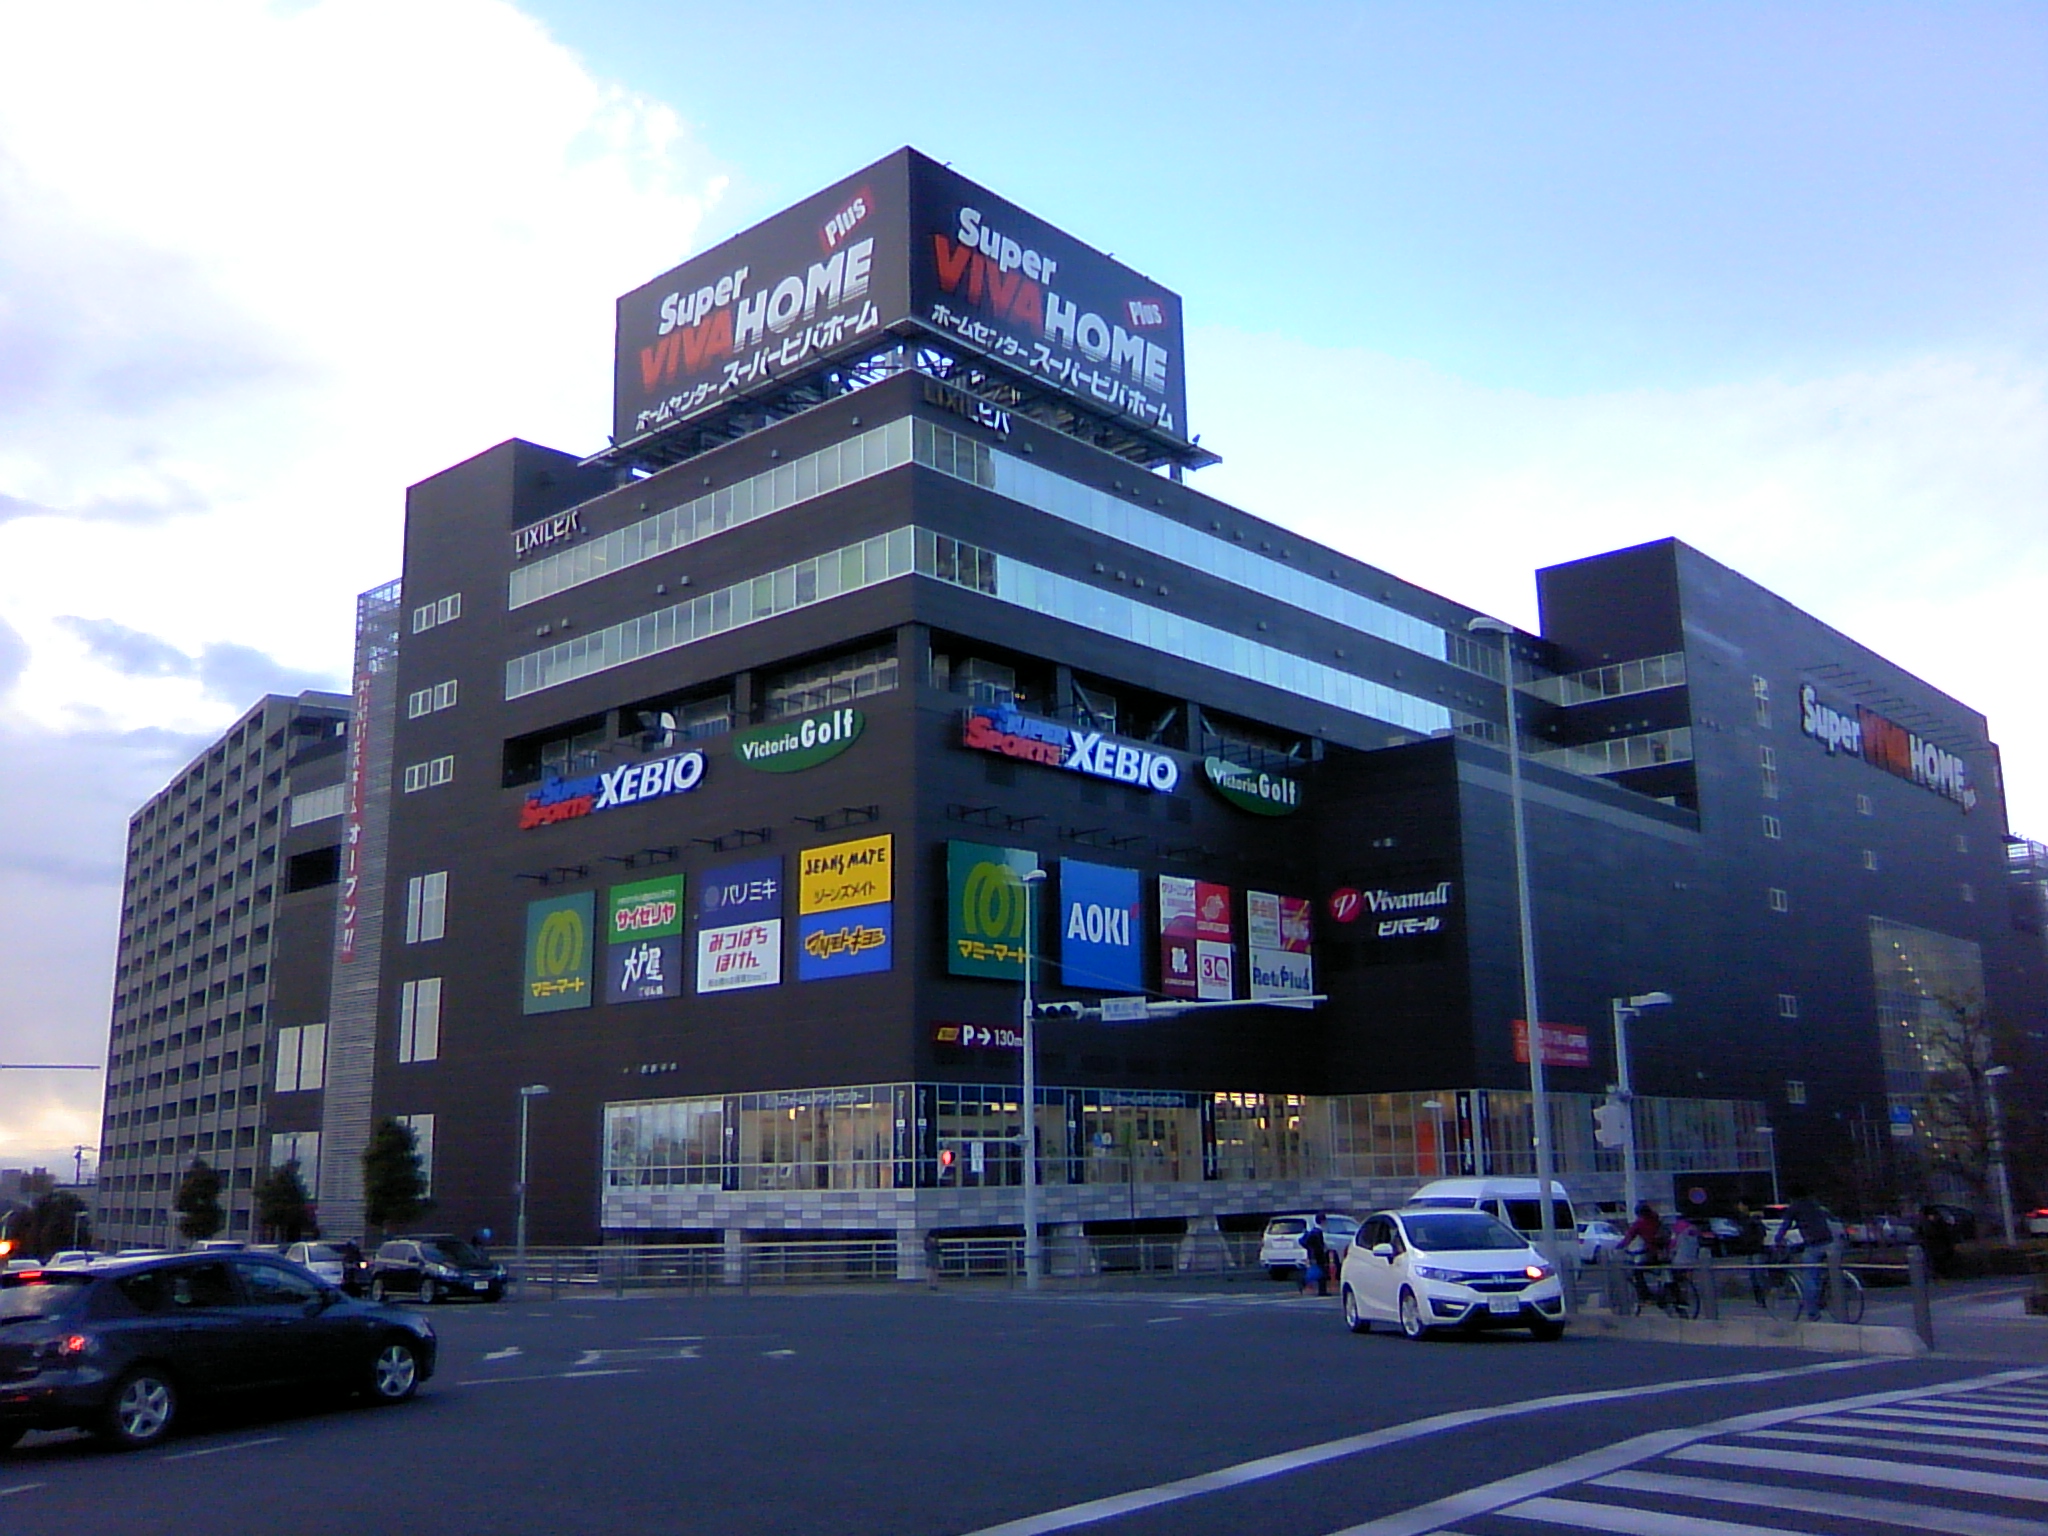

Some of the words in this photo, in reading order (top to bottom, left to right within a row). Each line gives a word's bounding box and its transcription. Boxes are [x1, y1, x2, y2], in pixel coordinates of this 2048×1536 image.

[824, 198, 866, 247] Plus
[958, 207, 1057, 285] Super
[658, 266, 749, 336] Super
[1128, 301, 1162, 326] Plus
[1801, 684, 1860, 752] Super
[1065, 730, 1179, 791] XEBIO
[596, 752, 703, 809] XEBIO
[805, 854, 845, 876] JEANS
[847, 848, 886, 869] MATE
[721, 878, 777, 907] パリミキ
[1364, 882, 1451, 913] Vivamall
[616, 902, 676, 931] サイゼリヤ
[1067, 902, 1130, 946] AOKI
[1378, 916, 1440, 936] ビバモール
[708, 926, 768, 953] みつばち
[715, 951, 760, 973] ほけん
[531, 976, 585, 997] マミーマート
